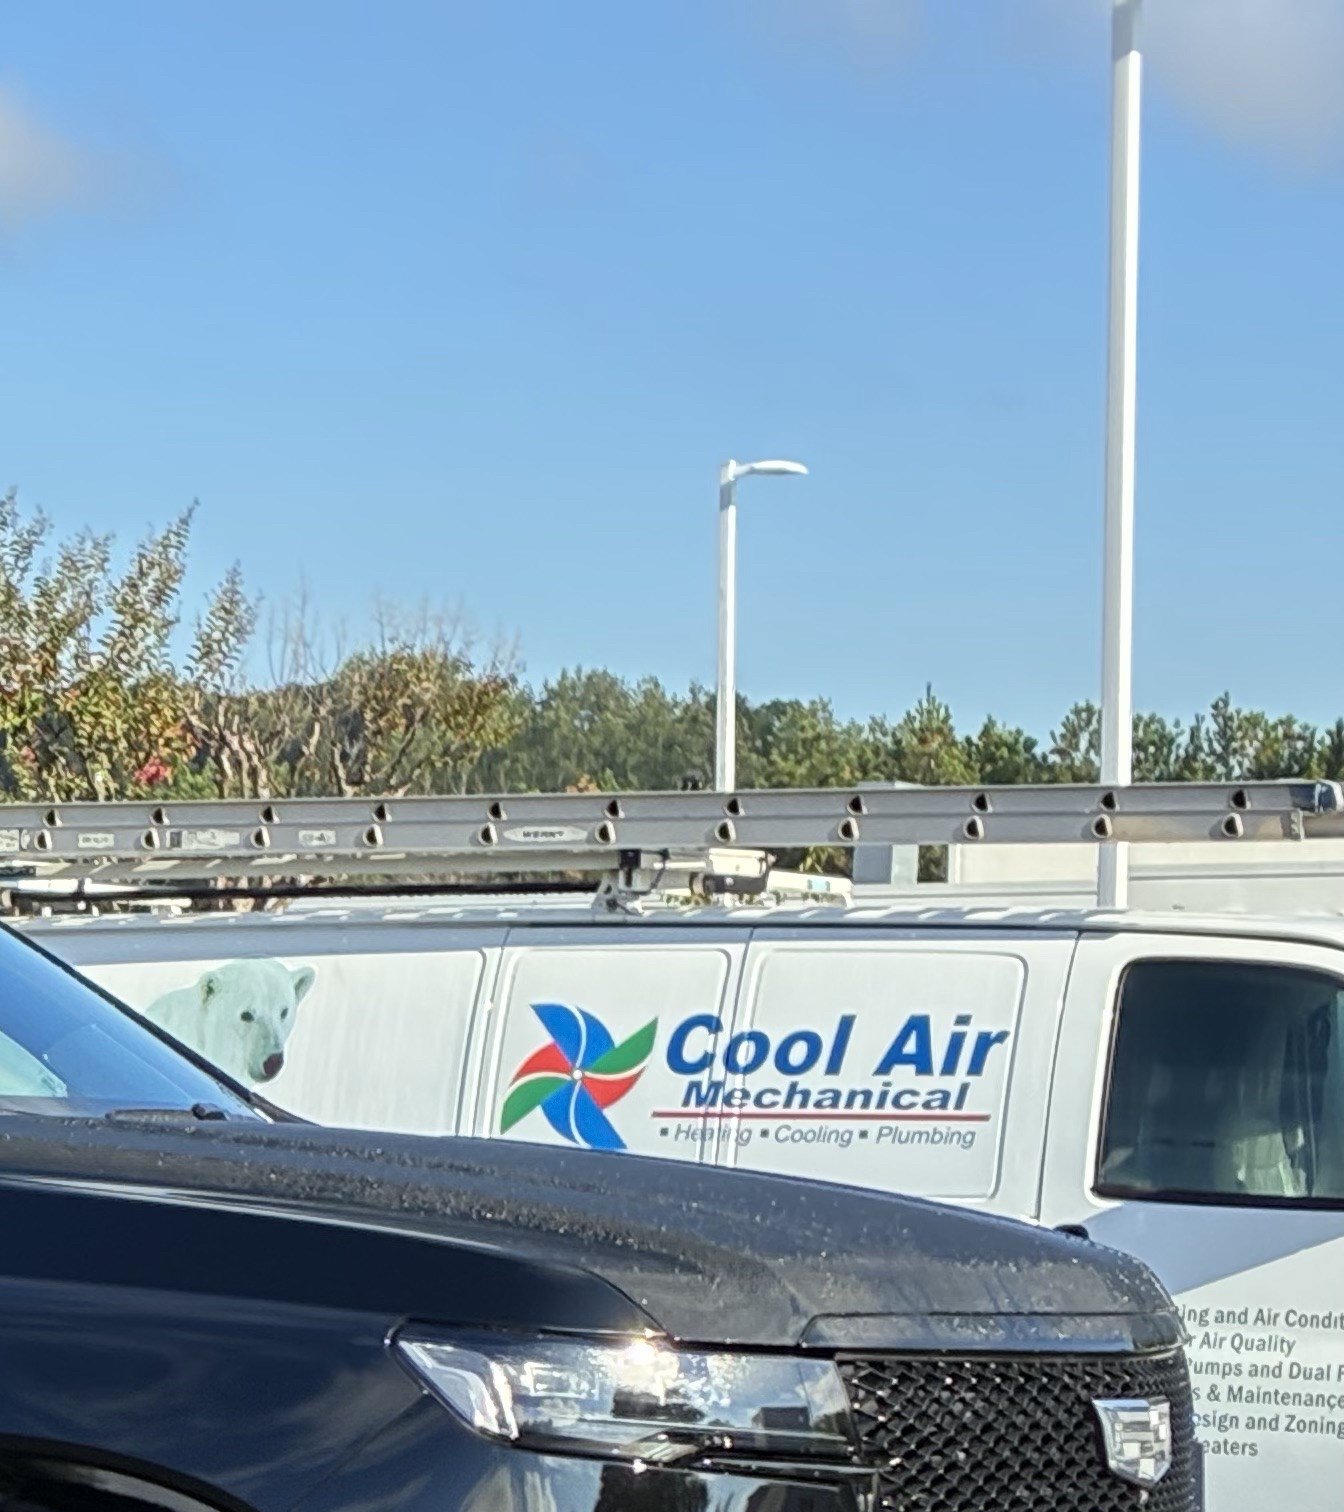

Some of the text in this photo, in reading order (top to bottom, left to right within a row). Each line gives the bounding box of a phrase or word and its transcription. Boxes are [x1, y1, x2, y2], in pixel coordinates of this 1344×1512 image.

[665, 1013, 1010, 1077] Cool Air
[680, 1081, 972, 1111] Mechanical
[774, 1124, 854, 1148] Cooling
[875, 1125, 977, 1150] Plumbing
[1214, 1306, 1249, 1325] and
[1253, 1307, 1281, 1327] Air
[1199, 1331, 1228, 1350] Air
[1230, 1332, 1297, 1358] Quality
[1248, 1360, 1284, 1379] and
[1288, 1361, 1332, 1382] Dual
[1206, 1383, 1222, 1402] &
[1194, 1410, 1344, 1440] esign and Zoning
[1202, 1439, 1259, 1457] eaters
